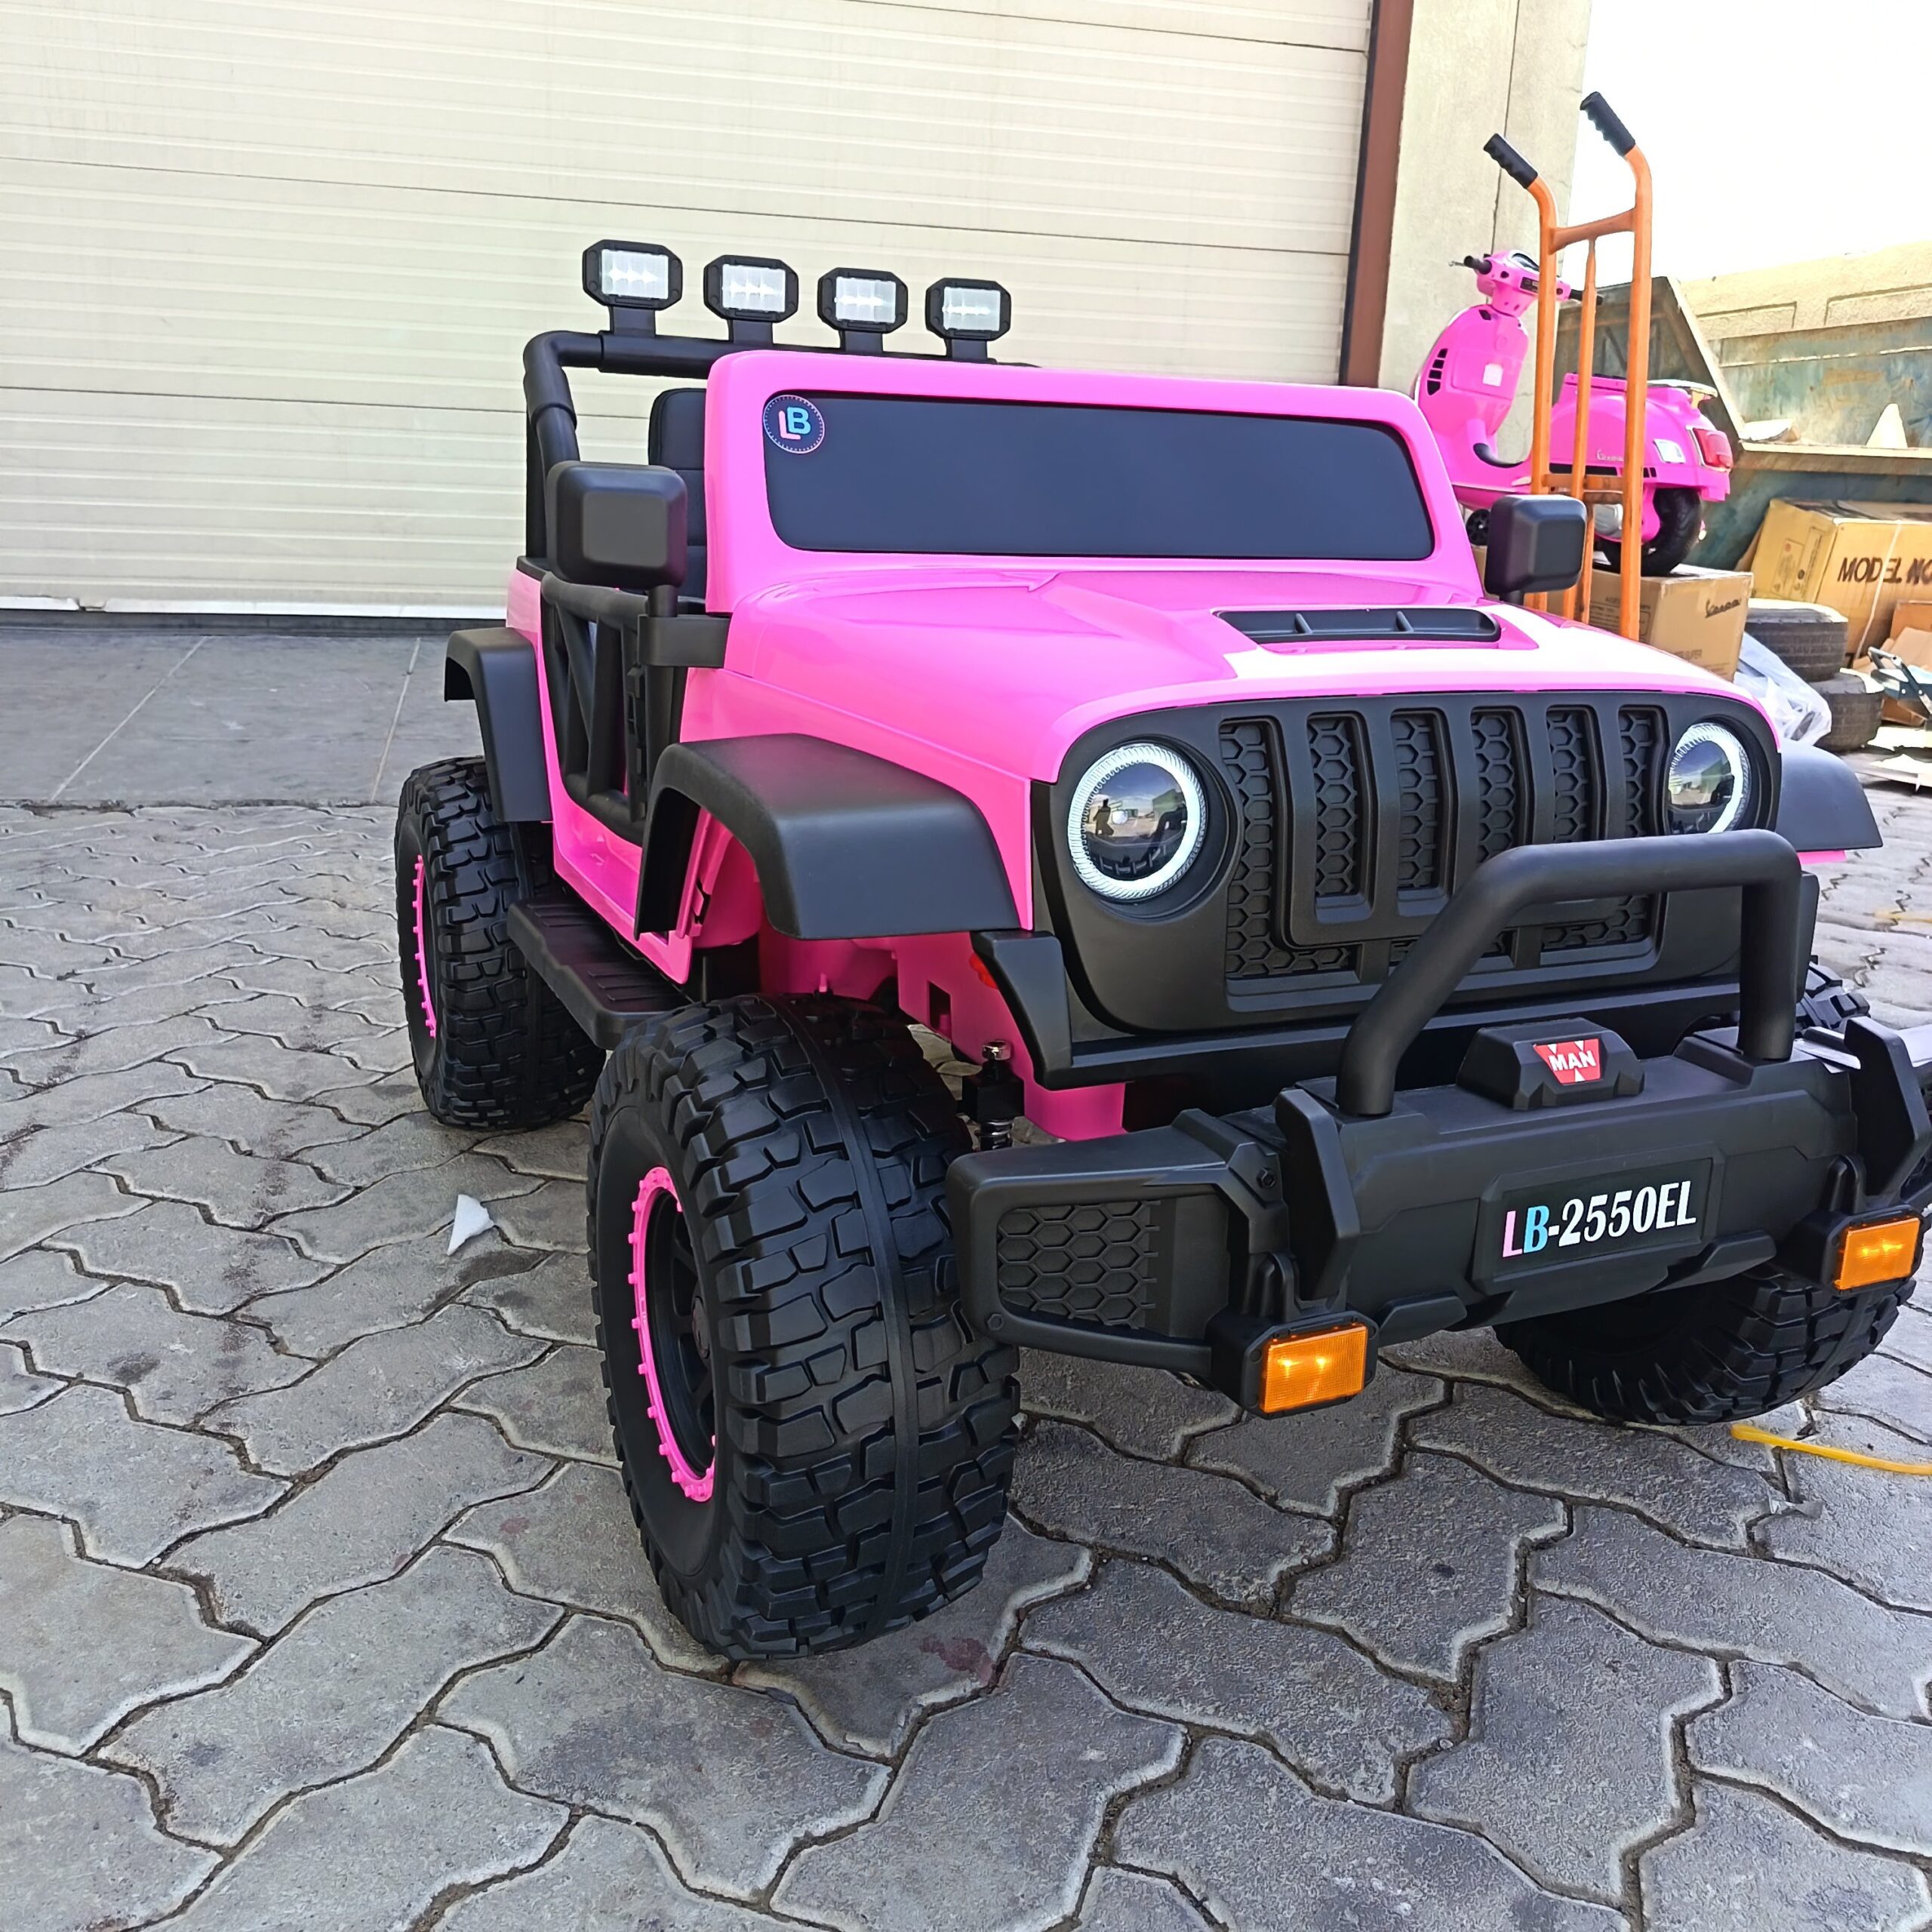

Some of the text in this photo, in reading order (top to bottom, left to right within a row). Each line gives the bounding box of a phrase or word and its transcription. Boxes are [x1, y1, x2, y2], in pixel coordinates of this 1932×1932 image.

[778, 407, 811, 440] LB
[1837, 557, 1903, 583] MODEL
[1548, 1050, 1597, 1072] MAN
[1502, 1180, 1697, 1258] LB-2550EL
